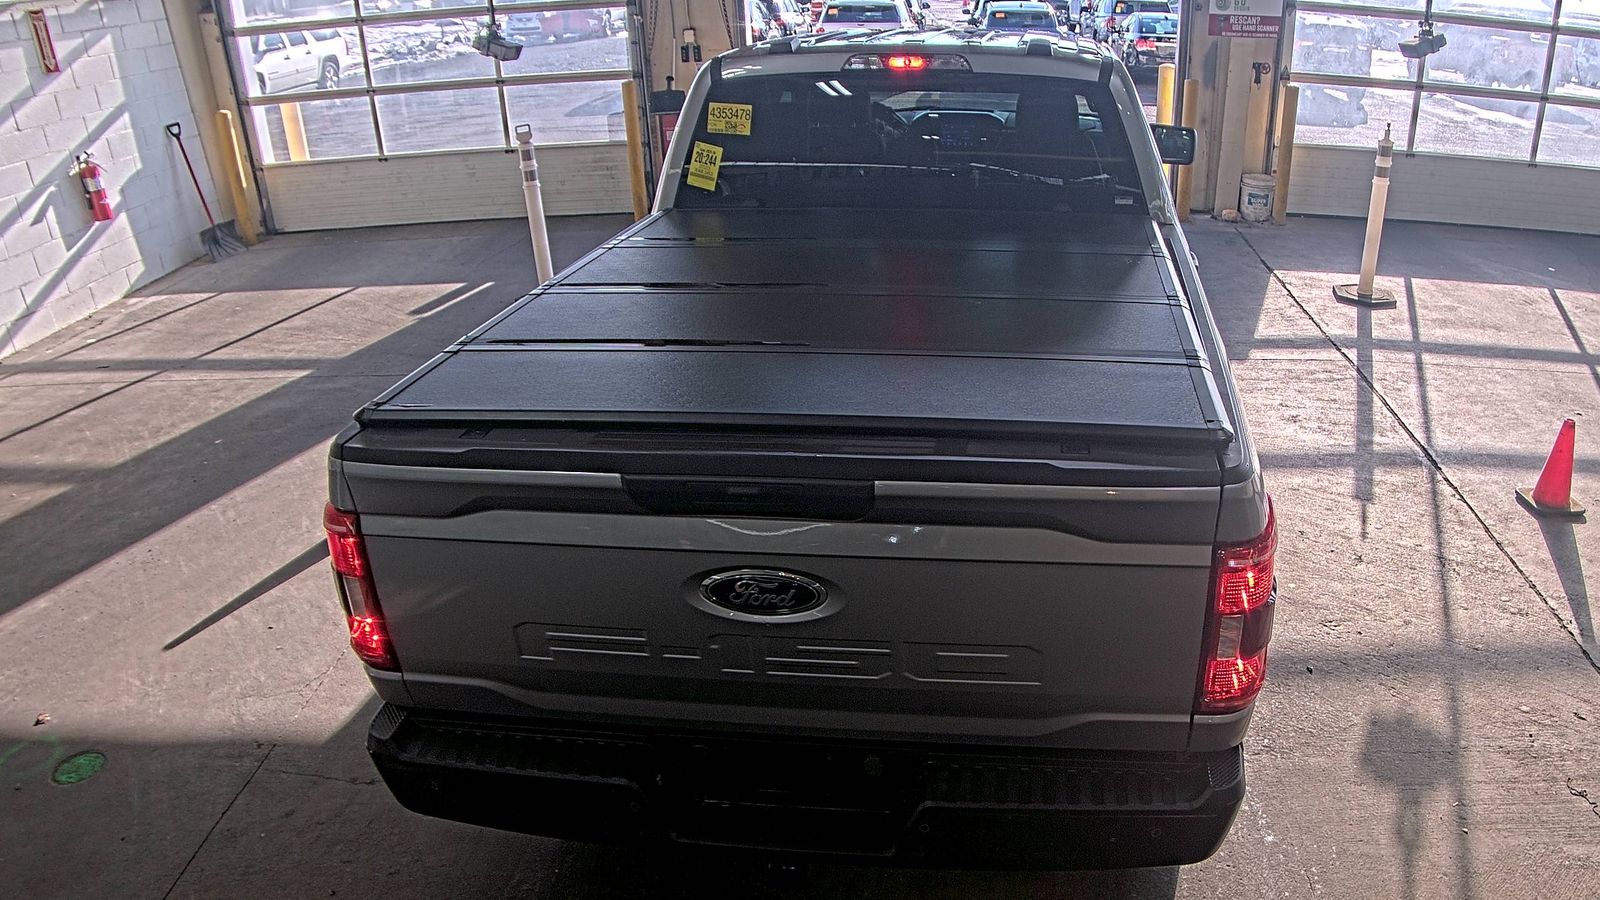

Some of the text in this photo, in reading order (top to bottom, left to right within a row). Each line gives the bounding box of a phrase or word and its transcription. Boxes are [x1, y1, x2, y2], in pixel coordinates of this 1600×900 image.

[1230, 15, 1261, 25] RESCAN?
[710, 106, 751, 121] 4353478
[695, 151, 718, 168] 20:244
[729, 580, 797, 606] Ford
[513, 621, 1043, 686] F-150
